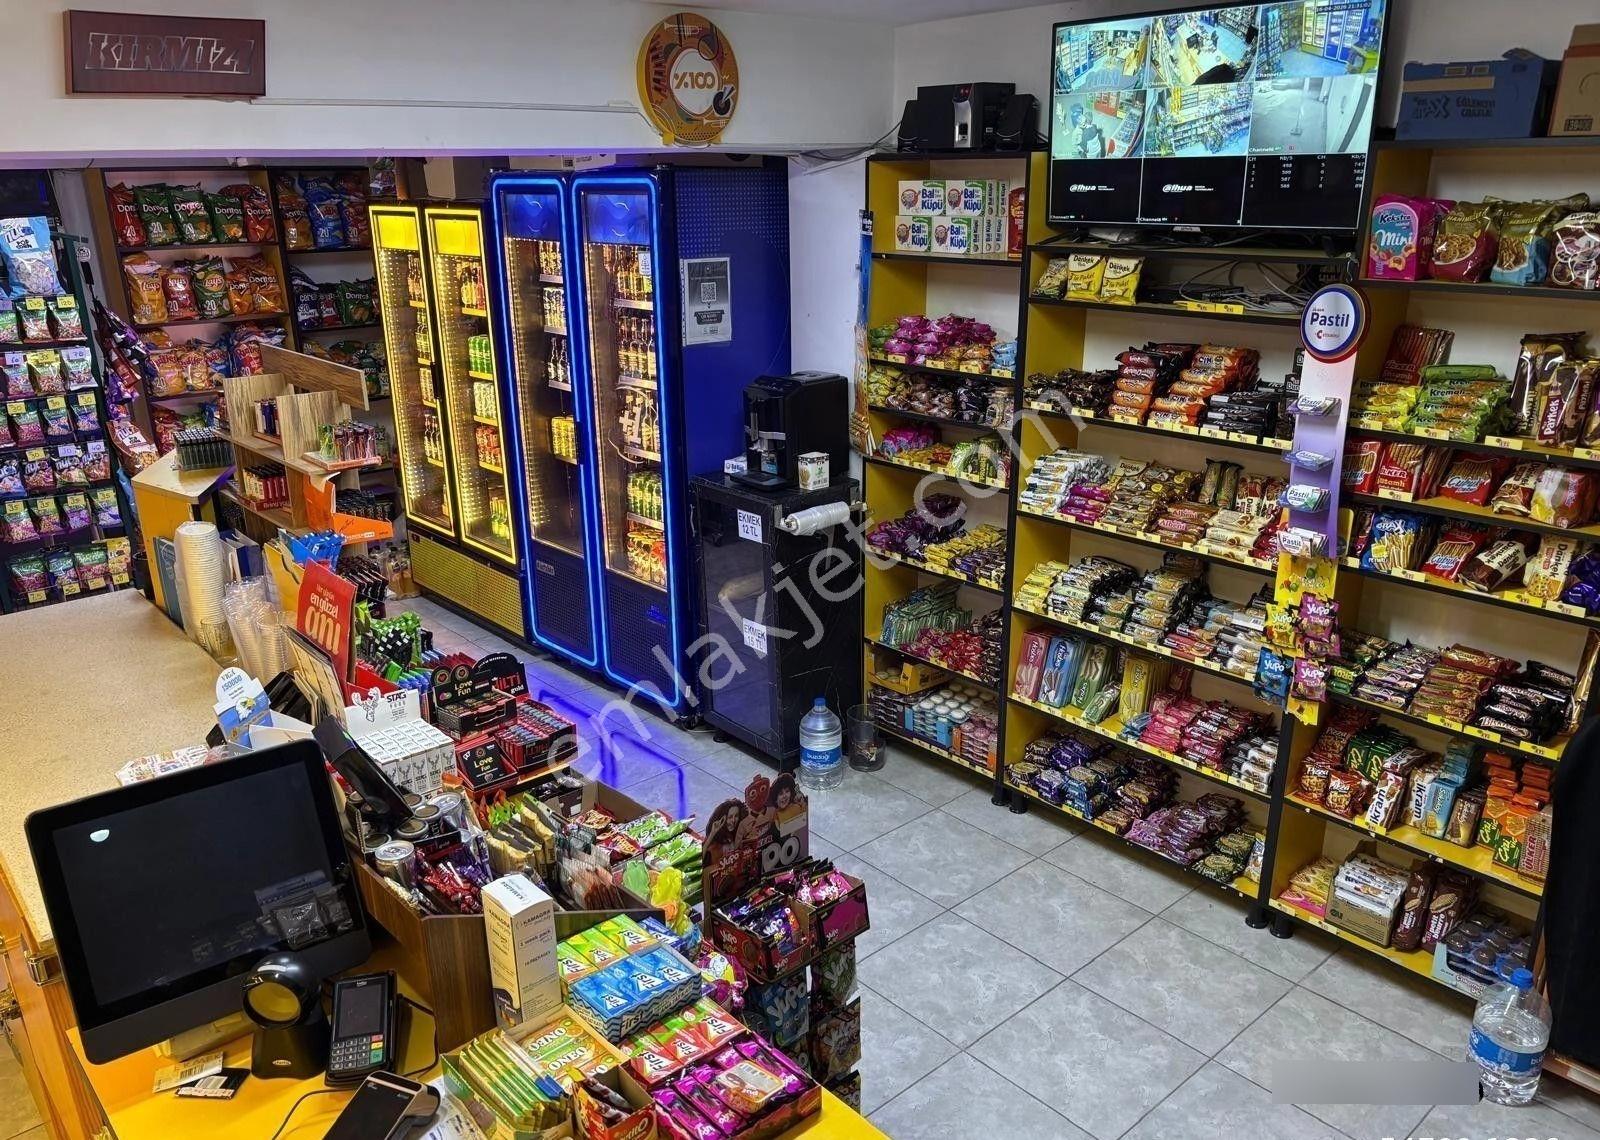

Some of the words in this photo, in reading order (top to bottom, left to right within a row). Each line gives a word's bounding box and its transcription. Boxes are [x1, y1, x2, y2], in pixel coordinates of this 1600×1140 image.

[922, 189, 935, 199] Bal
[963, 188, 975, 198] Bal
[921, 200, 943, 211] Küpü
[963, 200, 982, 212] Küpü
[911, 224, 922, 234] Bal
[950, 224, 961, 235] Bal
[911, 235, 928, 246] Küpü
[950, 237, 967, 249] Küpü
[1310, 312, 1350, 328] Pastil
[1544, 399, 1560, 436] Parkek
[738, 511, 761, 527] EKMEK
[742, 524, 750, 534] 12
[750, 526, 759, 538] TL
[1549, 542, 1569, 579] Dankek
[744, 623, 767, 641] EKMEK
[454, 680, 473, 691] Love
[387, 691, 408, 703] STAG
[457, 687, 472, 697] Fun
[473, 756, 494, 768] Love
[523, 909, 551, 925] KAMAGRA
[620, 1010, 645, 1032] First
[547, 1046, 588, 1072] ONEO
